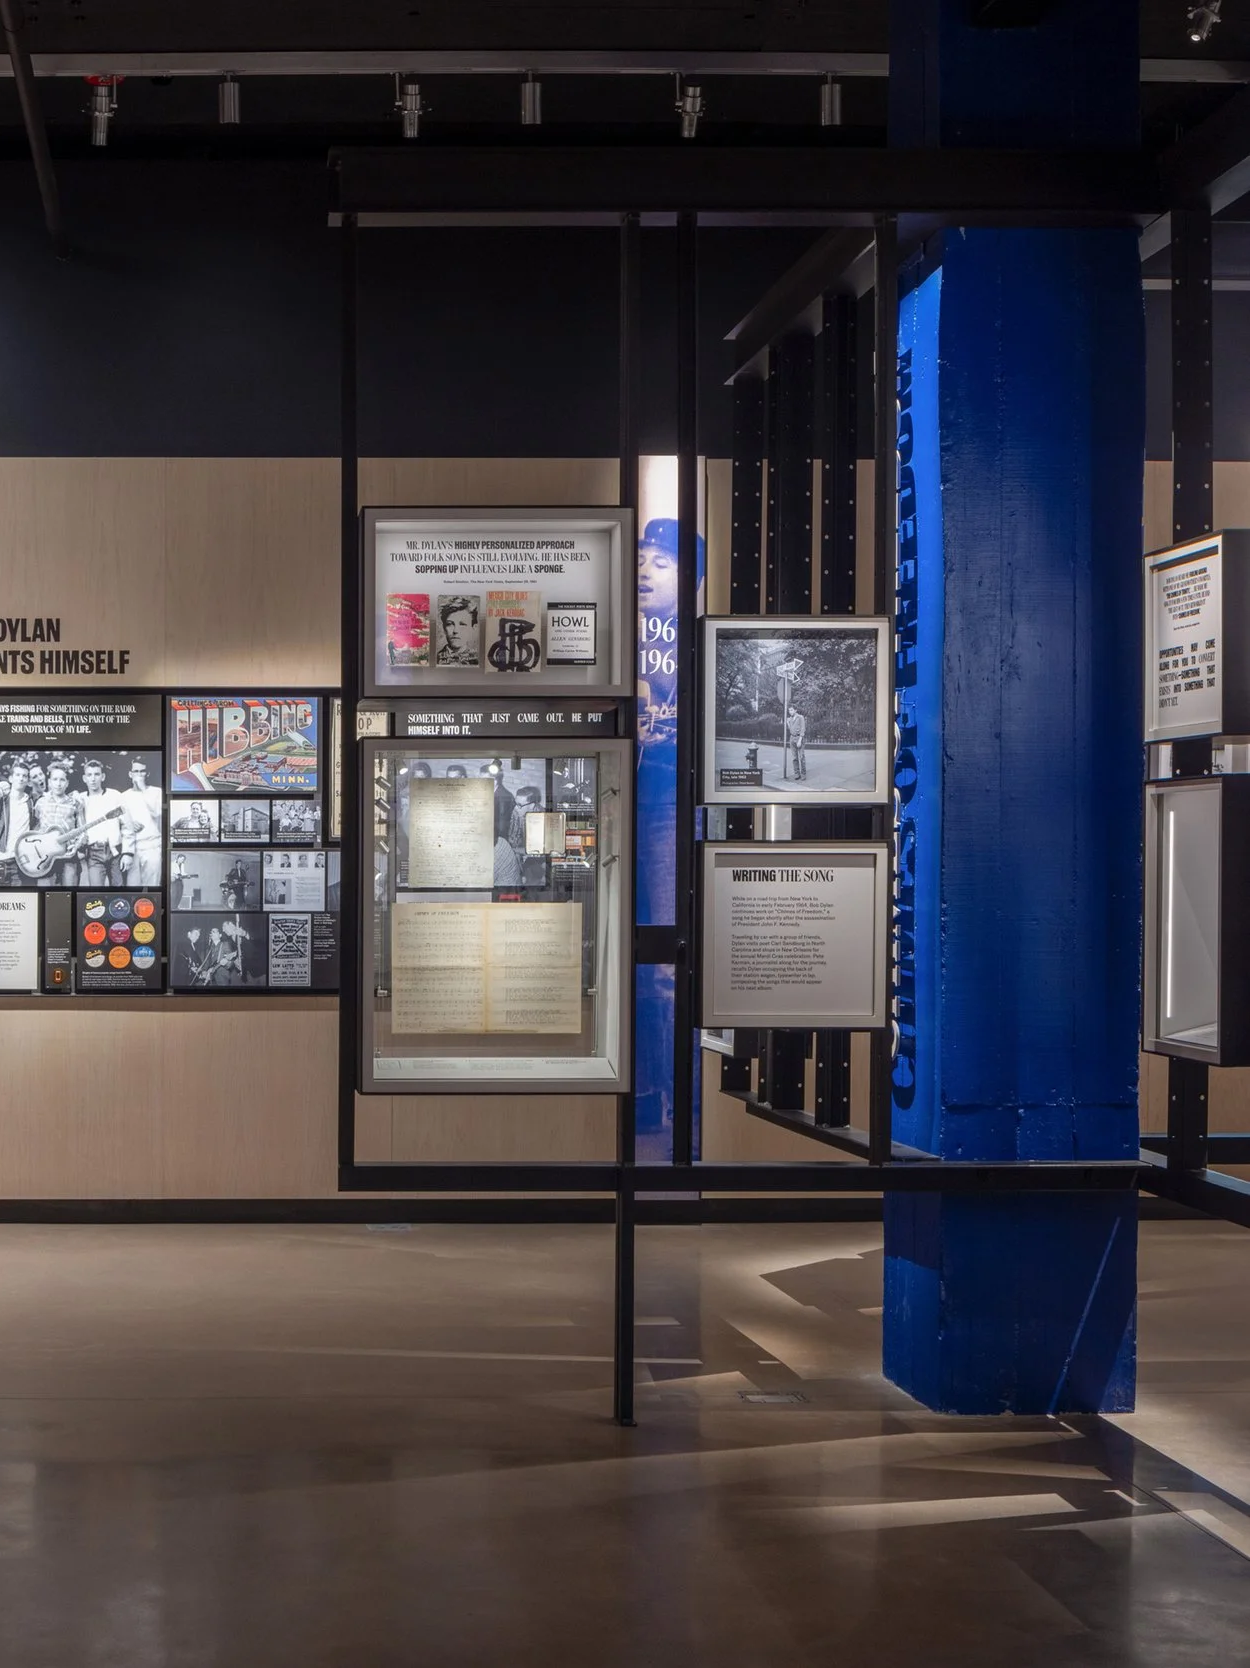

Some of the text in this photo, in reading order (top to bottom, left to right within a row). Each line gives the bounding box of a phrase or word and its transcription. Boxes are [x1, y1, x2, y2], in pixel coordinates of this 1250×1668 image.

[406, 540, 574, 549] MR. DYLAN'S HIGHLY PERSONALIZED APPROACH
[390, 552, 590, 561] TOWARD FOLK SONG IS STILL EVOLVING. HE HAS BEEN
[415, 565, 447, 573] SOPPING
[449, 565, 458, 573] UP
[460, 565, 507, 573] INFLUENCES
[509, 565, 526, 573] LIKE
[534, 564, 565, 573] SPONGE.
[552, 616, 589, 627] HOWL
[640, 617, 678, 642] 196
[40, 650, 130, 674] HIMSELF
[640, 650, 678, 674] 196
[44, 715, 64, 724] BELLS,
[408, 713, 602, 723] SOMETHING THAT JUST CAME OUT. HE PUT
[408, 726, 471, 735] HIMSELF INTO IT.
[173, 702, 312, 774] HIBBING
[272, 775, 310, 784] MINN.
[732, 870, 833, 882] WRITING THE SONG
